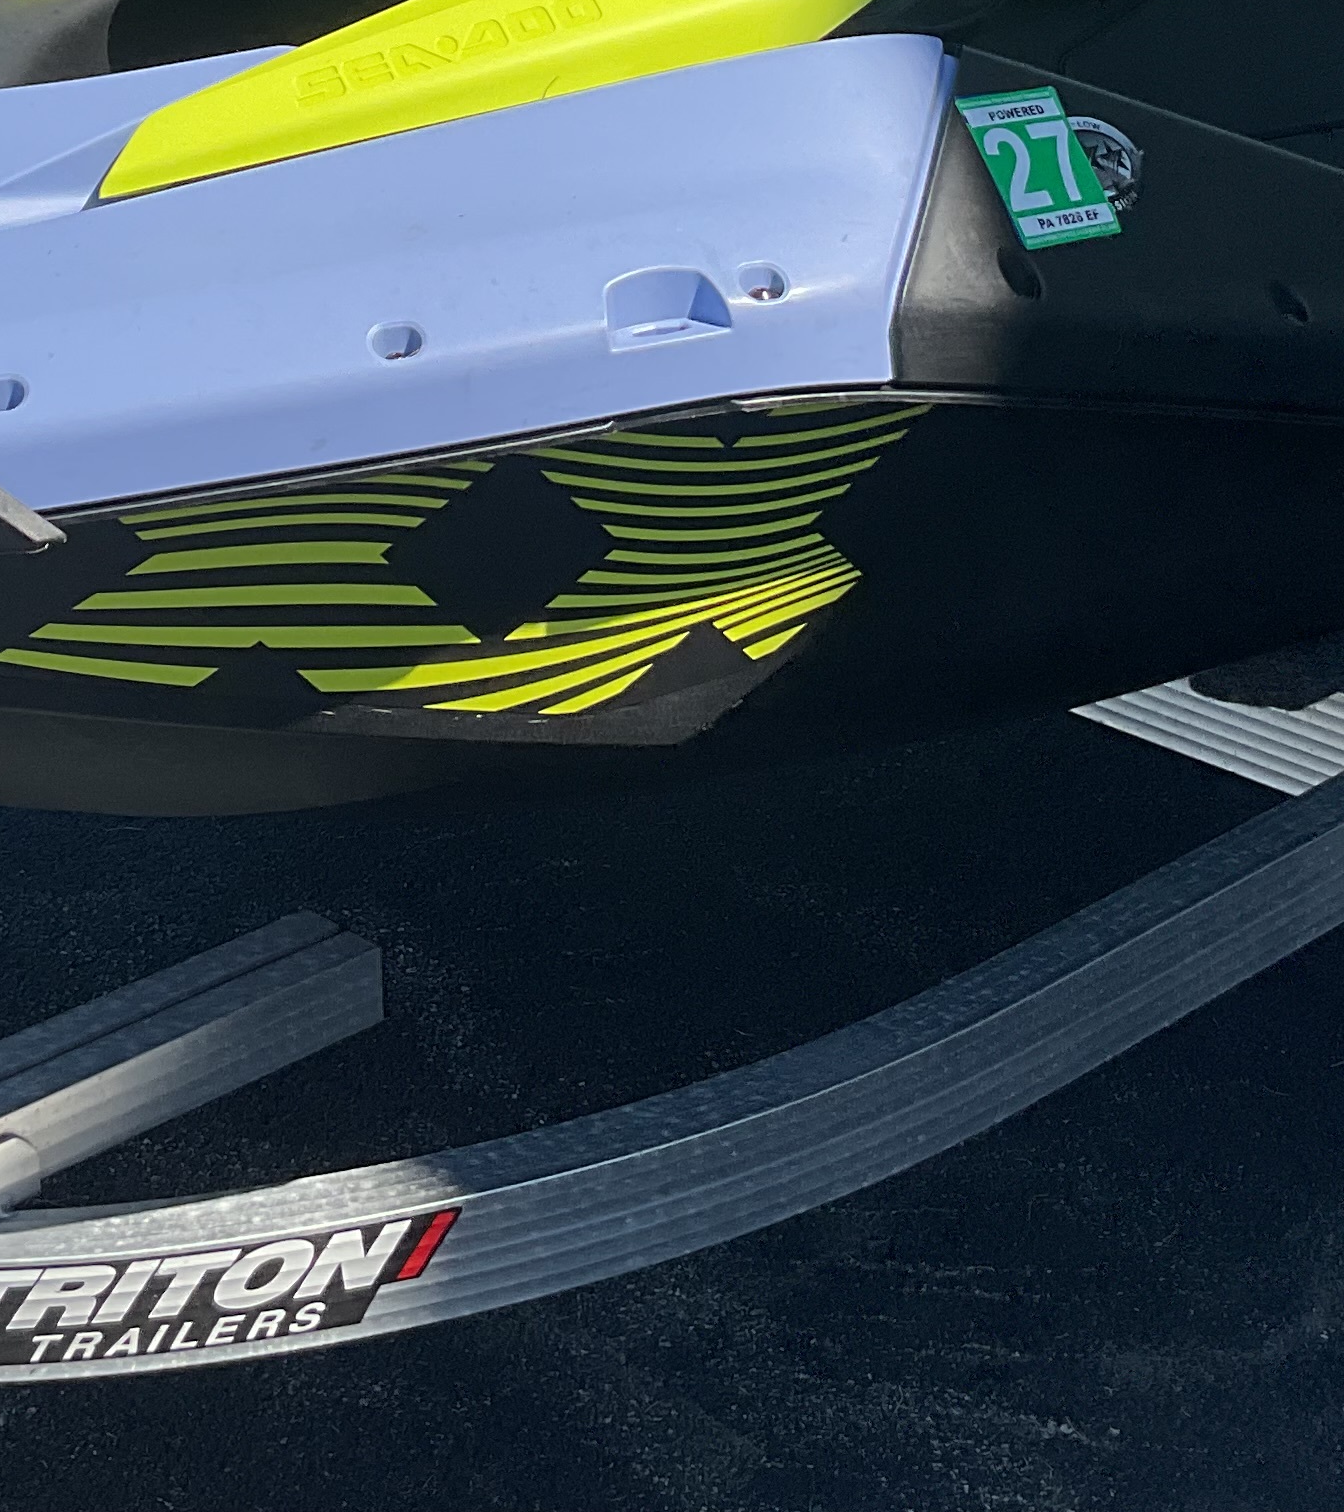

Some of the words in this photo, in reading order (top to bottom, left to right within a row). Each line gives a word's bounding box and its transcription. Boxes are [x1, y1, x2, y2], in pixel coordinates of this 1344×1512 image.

[988, 104, 1045, 121] POWERED
[983, 120, 1083, 212] 27
[1037, 216, 1054, 230] PA
[29, 1302, 327, 1364] TRAILERS
